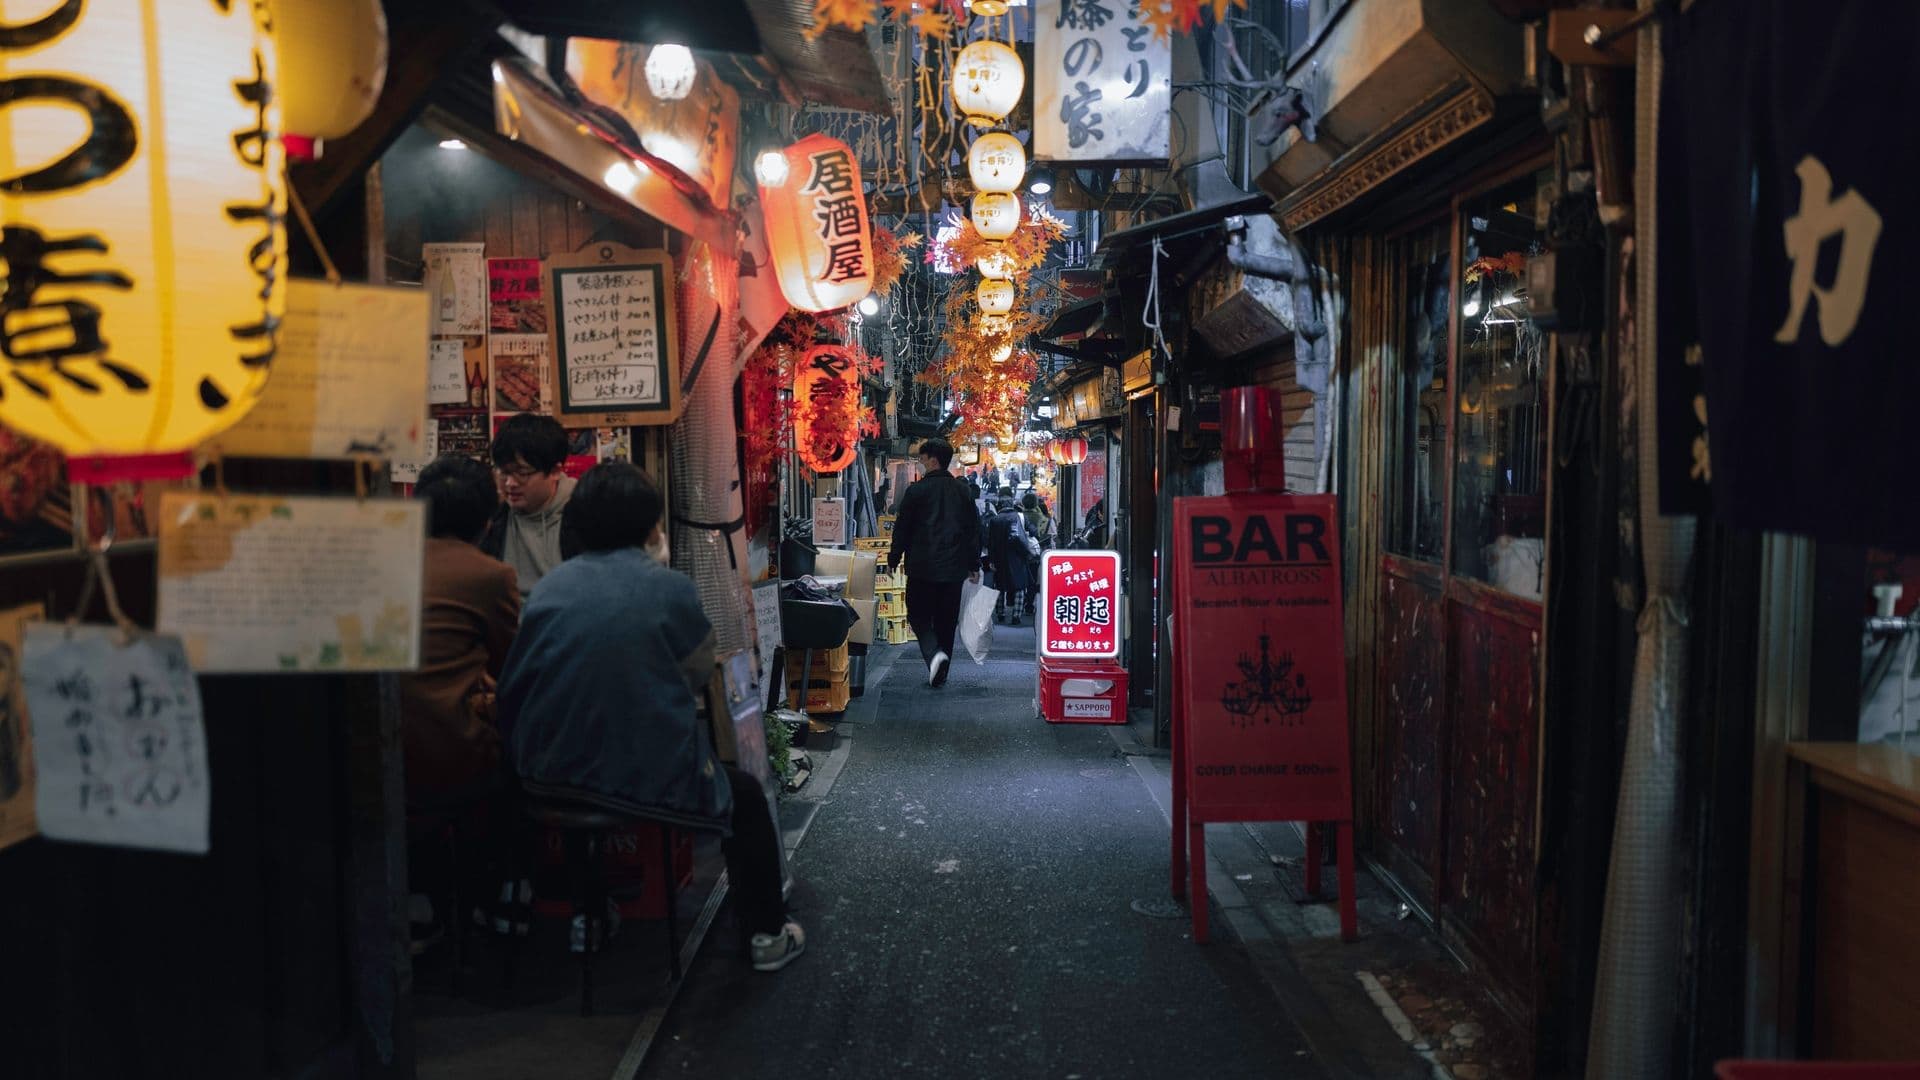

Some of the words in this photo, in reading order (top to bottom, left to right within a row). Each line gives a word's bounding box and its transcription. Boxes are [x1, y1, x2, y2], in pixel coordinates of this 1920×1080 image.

[0, 0, 150, 399] つ煮
[806, 150, 866, 283] 居酒屋
[1774, 155, 1883, 346] 力
[1190, 514, 1331, 563] BAR
[1065, 569, 1094, 586] スタミナ
[1207, 567, 1322, 587] ALBATROSS
[1056, 596, 1109, 624] 朝起
[1194, 597, 1237, 609] Second
[1074, 703, 1110, 712] SAPPORO
[1196, 765, 1236, 777] COVER
[1240, 764, 1287, 776] CHARGE
